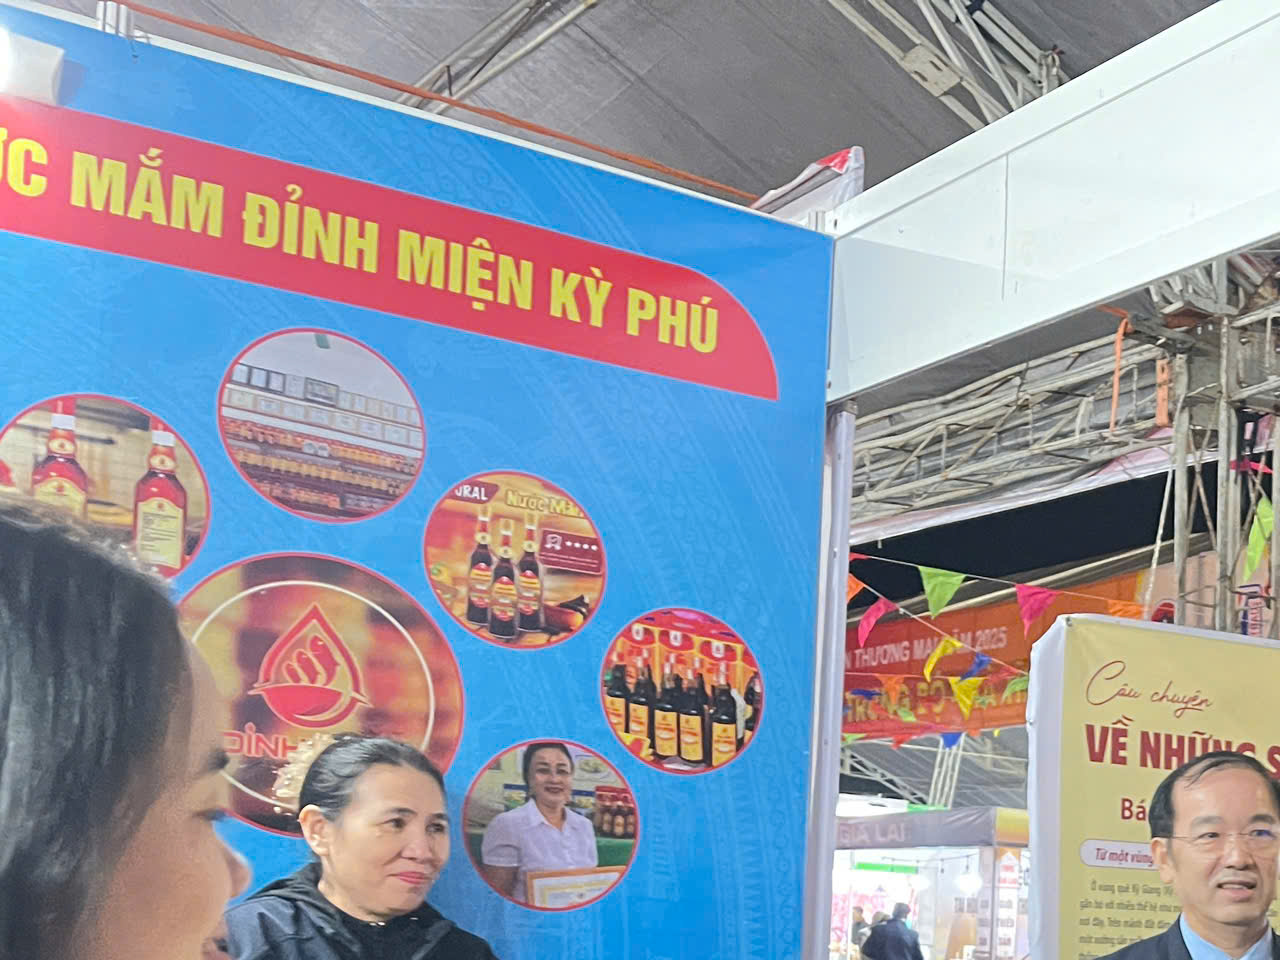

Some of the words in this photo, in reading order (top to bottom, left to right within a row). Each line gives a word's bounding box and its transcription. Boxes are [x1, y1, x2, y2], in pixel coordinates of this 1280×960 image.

[69, 147, 224, 238] MẮM
[241, 185, 379, 274] ĐỈNH
[398, 238, 533, 311] MIỆN
[550, 266, 614, 327] KỲ
[627, 286, 719, 354] PHÚ
[1085, 714, 1135, 765] VỀ
